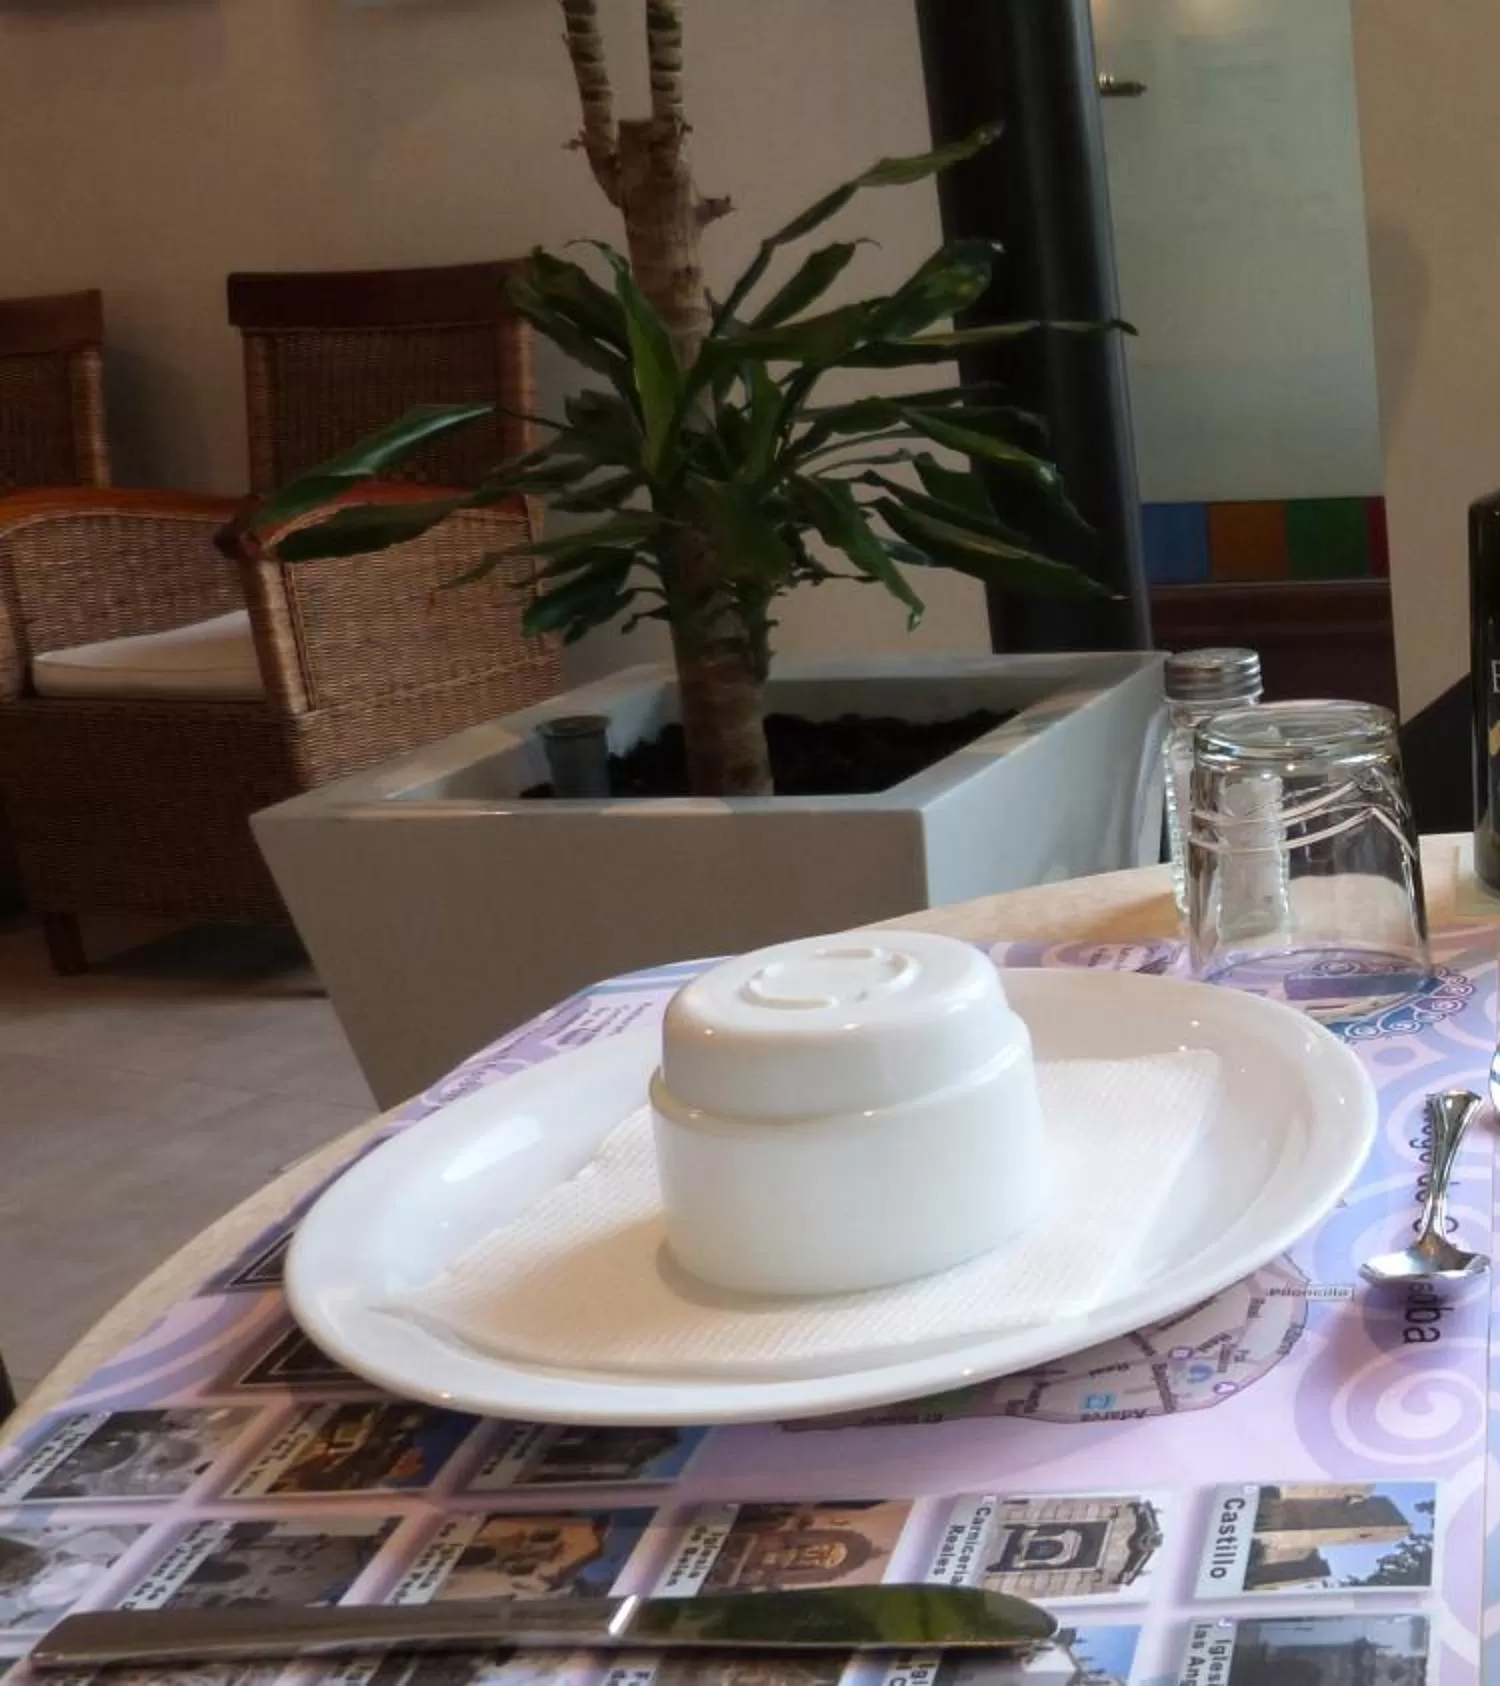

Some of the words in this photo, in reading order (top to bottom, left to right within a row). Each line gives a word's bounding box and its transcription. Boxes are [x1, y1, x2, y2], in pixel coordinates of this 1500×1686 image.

[932, 1524, 966, 1577] Reales
[951, 1506, 993, 1586] Carnicería
[1209, 1496, 1246, 1580] Castillo
